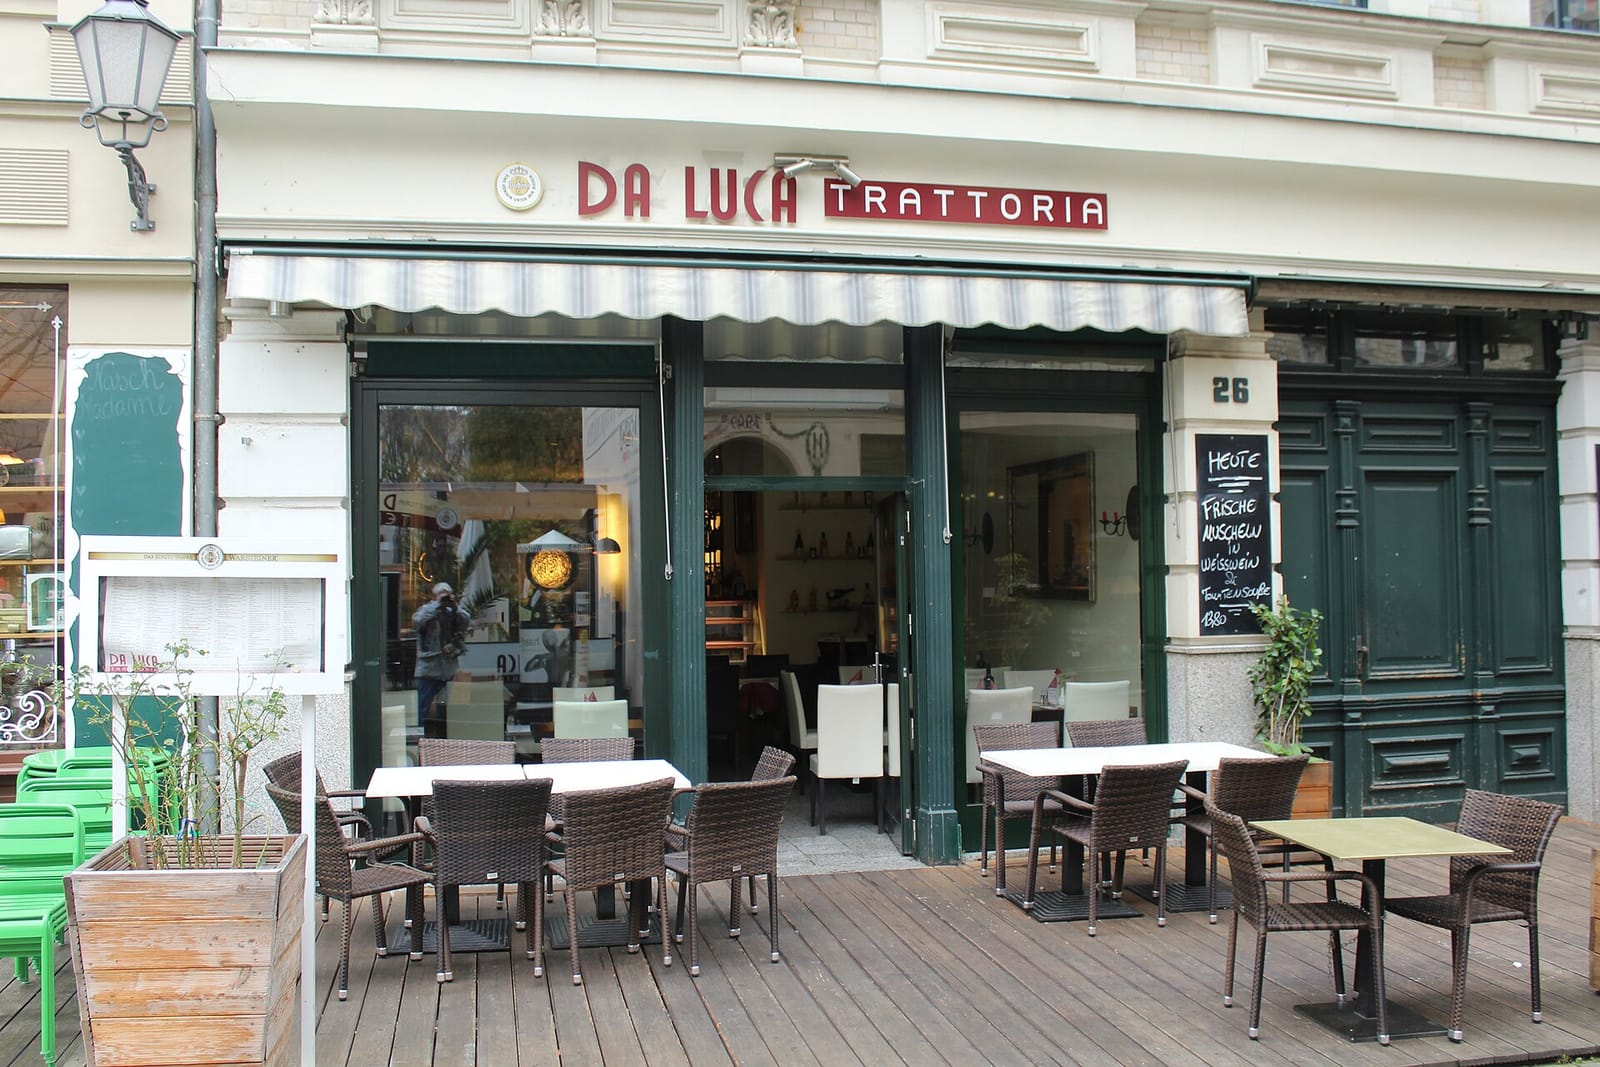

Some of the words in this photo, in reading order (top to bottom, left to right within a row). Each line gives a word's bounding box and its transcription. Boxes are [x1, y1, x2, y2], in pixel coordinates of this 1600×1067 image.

[578, 160, 650, 217] DA
[685, 165, 797, 224] LUCA
[830, 183, 1104, 226] TRATTORIA
[1212, 377, 1249, 403] 26
[1208, 450, 1262, 474] HEUTE
[1201, 496, 1257, 521] FRISCHE
[1202, 522, 1263, 542] MUSCHELN
[1200, 551, 1260, 573] WEISSWEIN
[109, 653, 127, 666] DA
